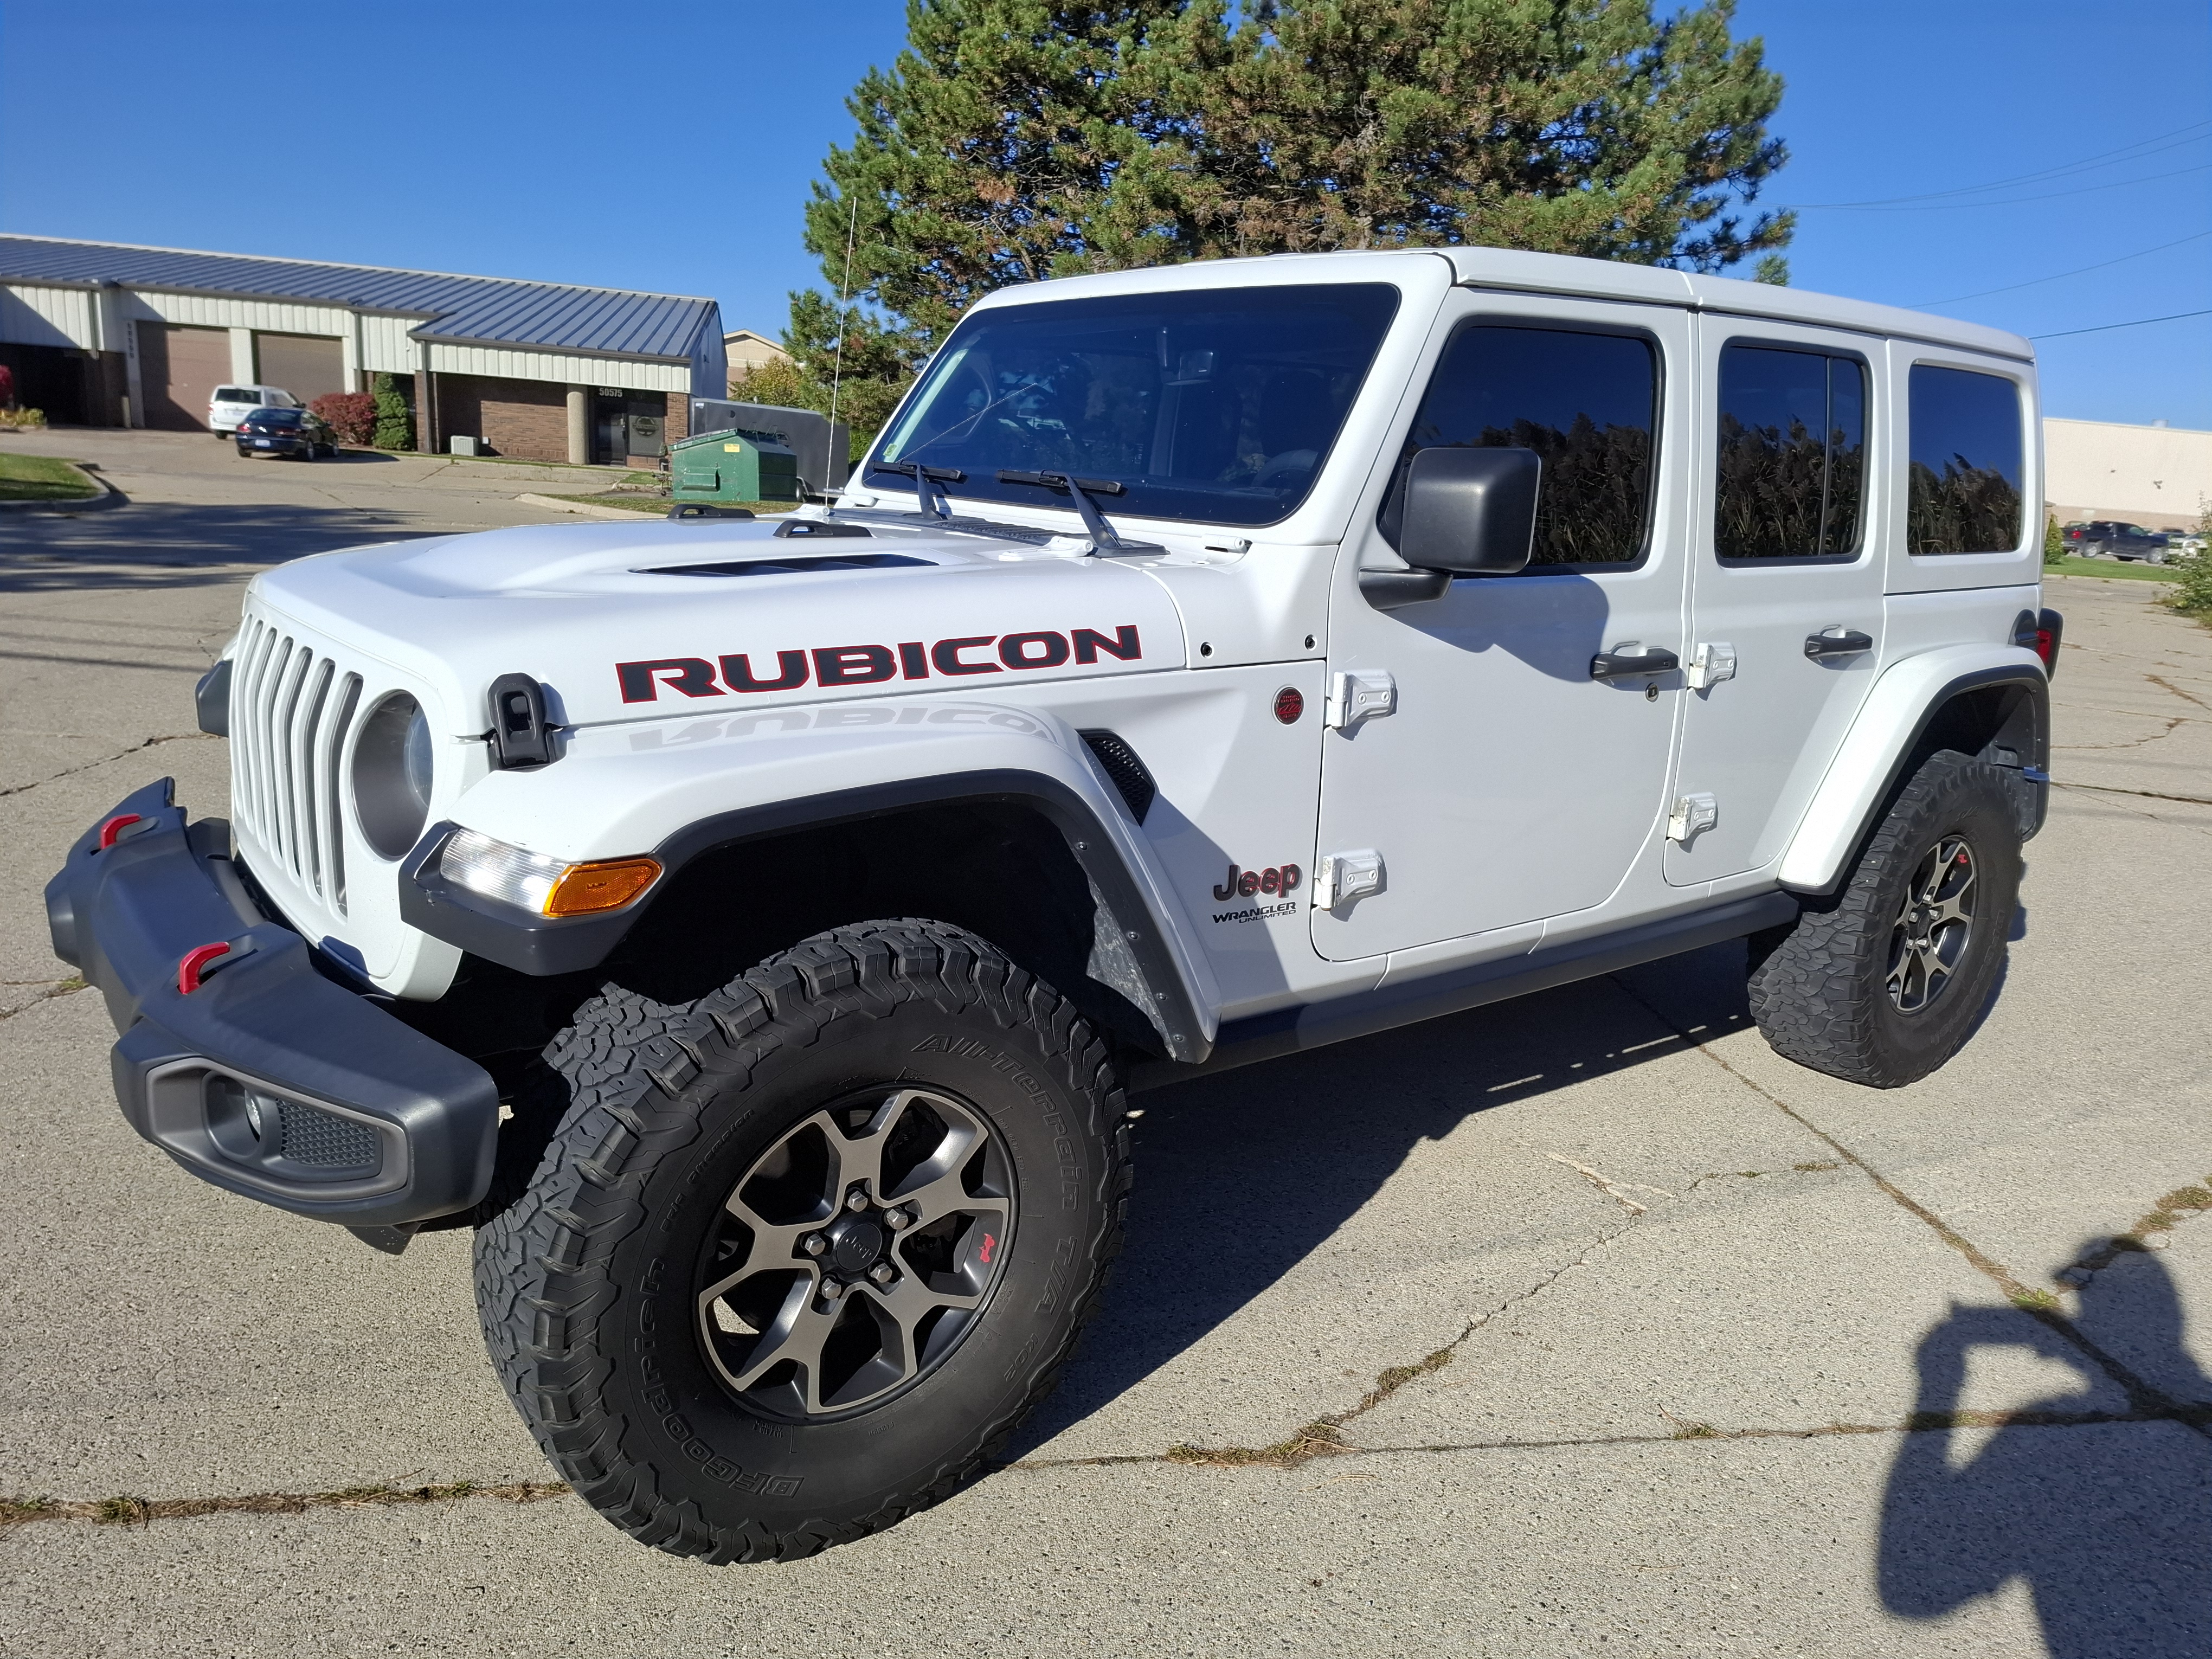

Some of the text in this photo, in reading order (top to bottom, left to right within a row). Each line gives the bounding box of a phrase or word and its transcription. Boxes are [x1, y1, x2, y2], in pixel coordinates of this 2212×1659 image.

[599, 388, 622, 397] 50575
[615, 625, 1142, 704] RUBICON
[1213, 863, 1301, 902] Jeep
[1212, 902, 1296, 924] WRANGLER
[1239, 909, 1296, 924] UNLIMITED
[846, 1236, 872, 1258] Jeep
